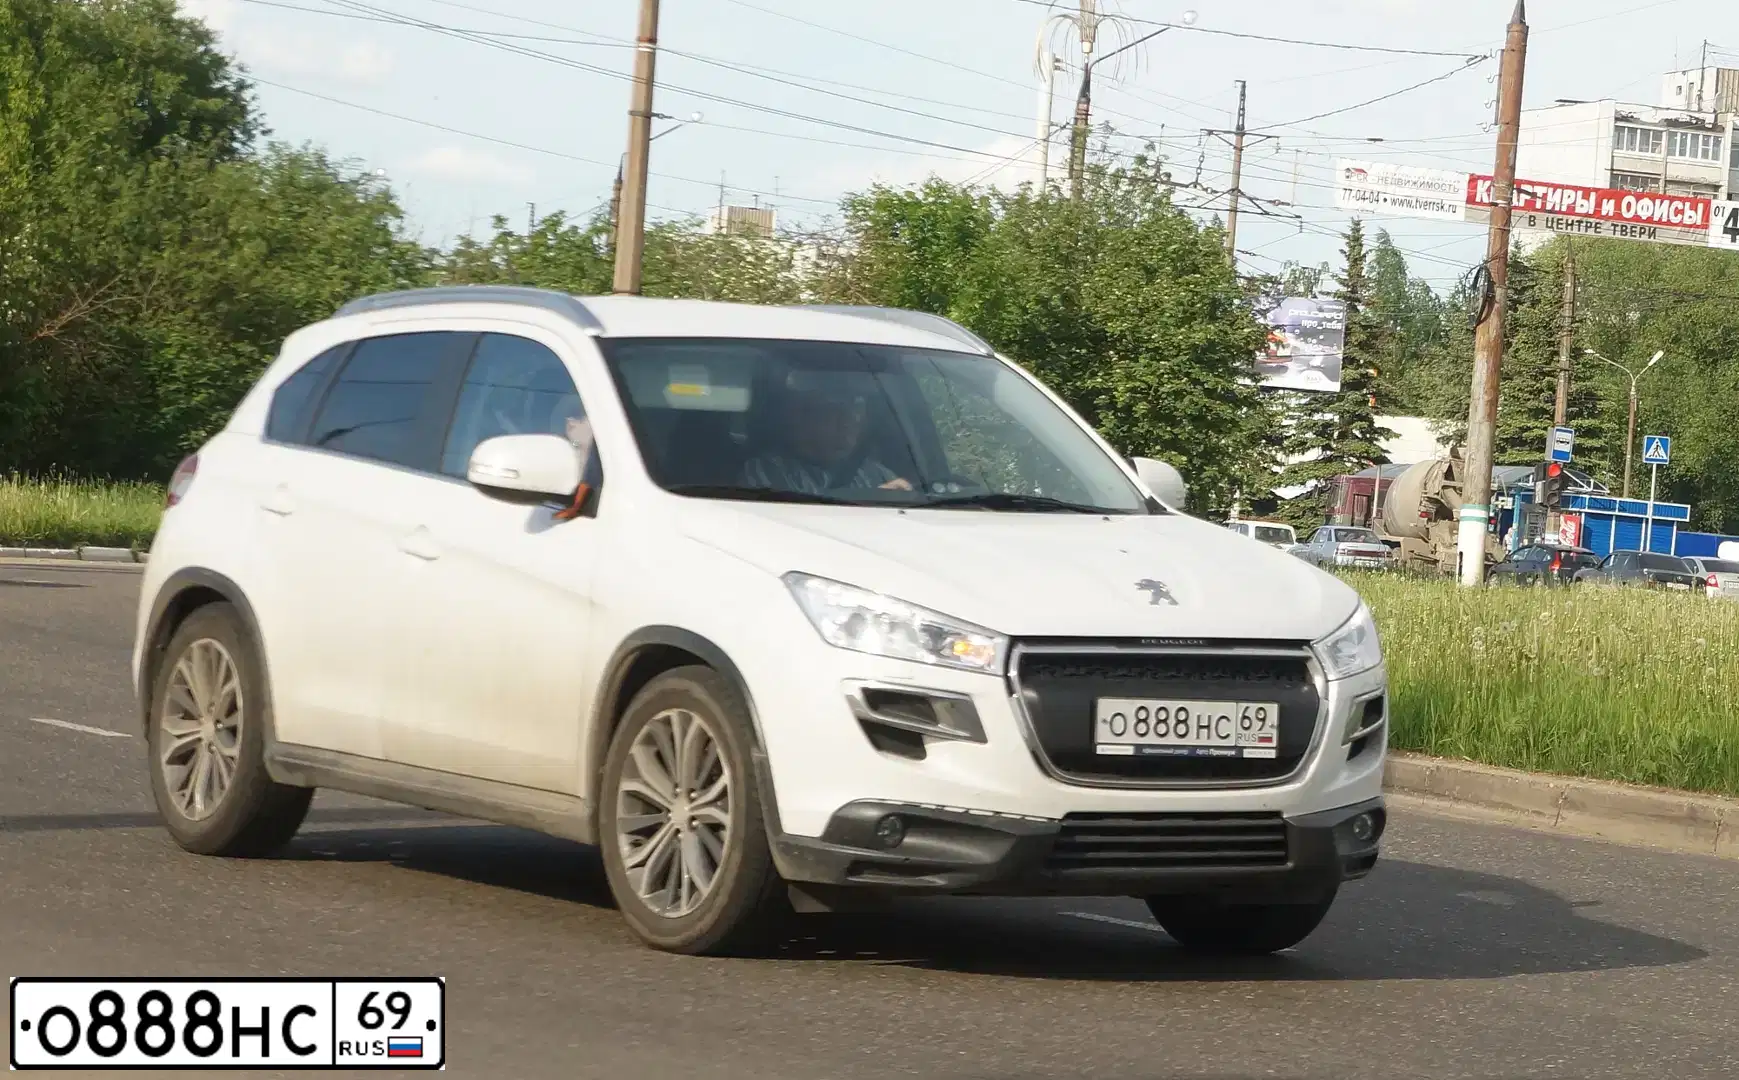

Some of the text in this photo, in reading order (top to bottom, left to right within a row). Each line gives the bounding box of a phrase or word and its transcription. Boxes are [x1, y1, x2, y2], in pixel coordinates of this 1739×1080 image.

[1377, 175, 1460, 193] НЕДВИЖИМОСТЬ
[1342, 188, 1457, 214] 77-04-04 www.tverrsk.ru
[1475, 179, 1596, 215] КРТИРЫ
[1621, 195, 1704, 225] ОФИСЫ
[1545, 216, 1603, 234] ЦЕНТРЕ
[1611, 223, 1657, 240] ТВЕРИ
[1239, 706, 1268, 732] 69
[1237, 733, 1257, 743] RUS
